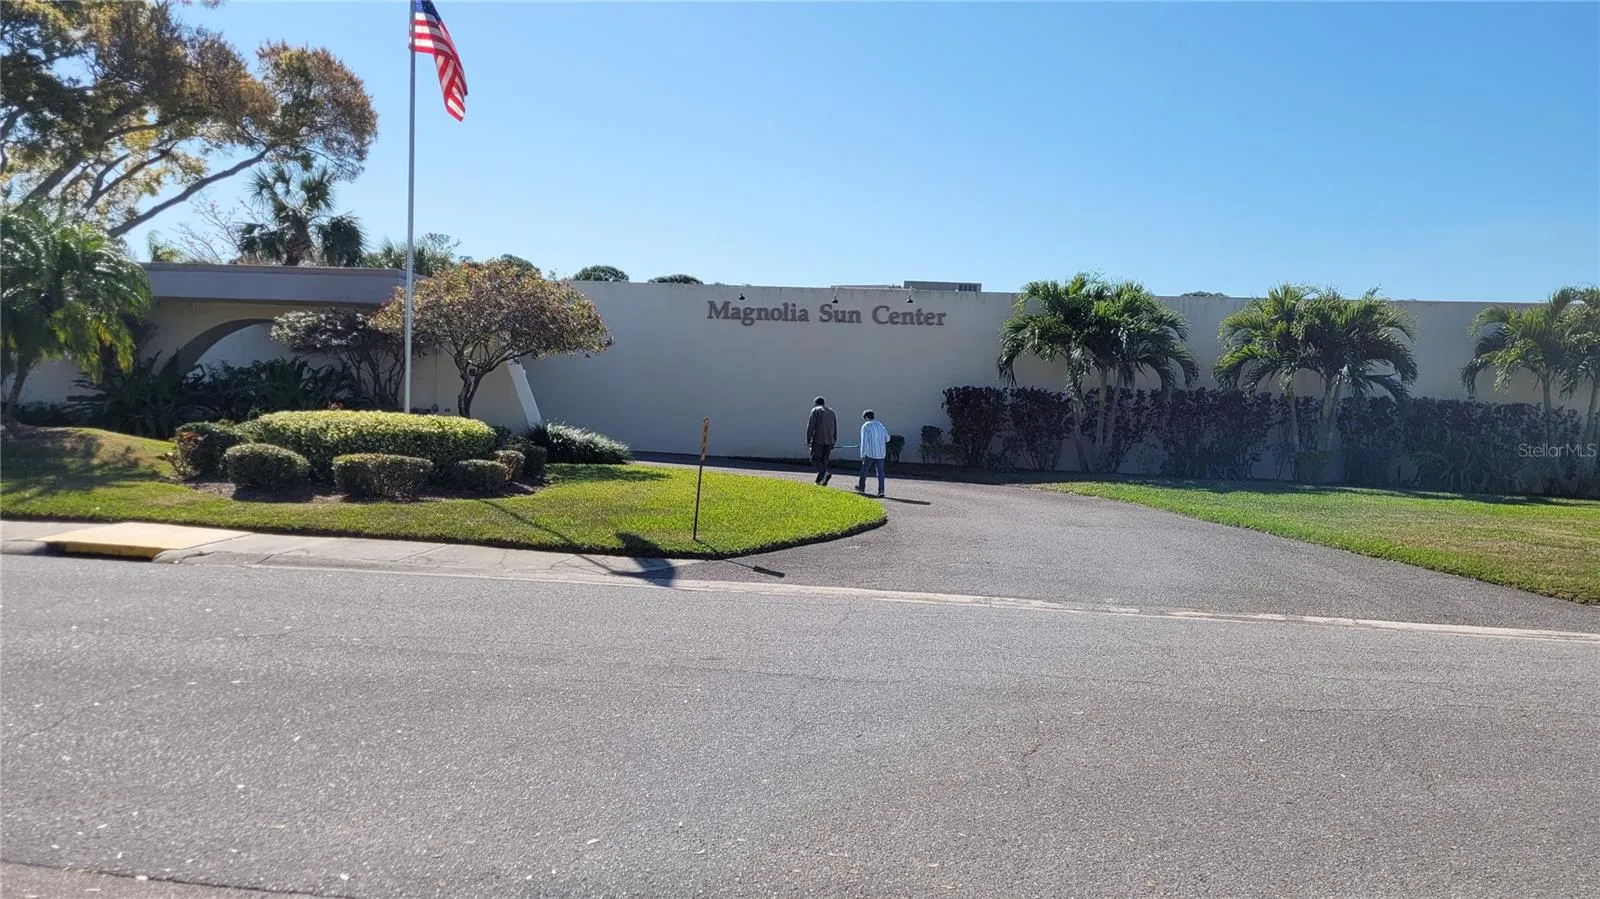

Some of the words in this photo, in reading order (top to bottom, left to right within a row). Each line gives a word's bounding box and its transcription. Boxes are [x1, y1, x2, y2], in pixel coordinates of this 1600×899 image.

[707, 300, 810, 326] Magnolia
[819, 303, 862, 324] Sun
[872, 305, 947, 326] Center
